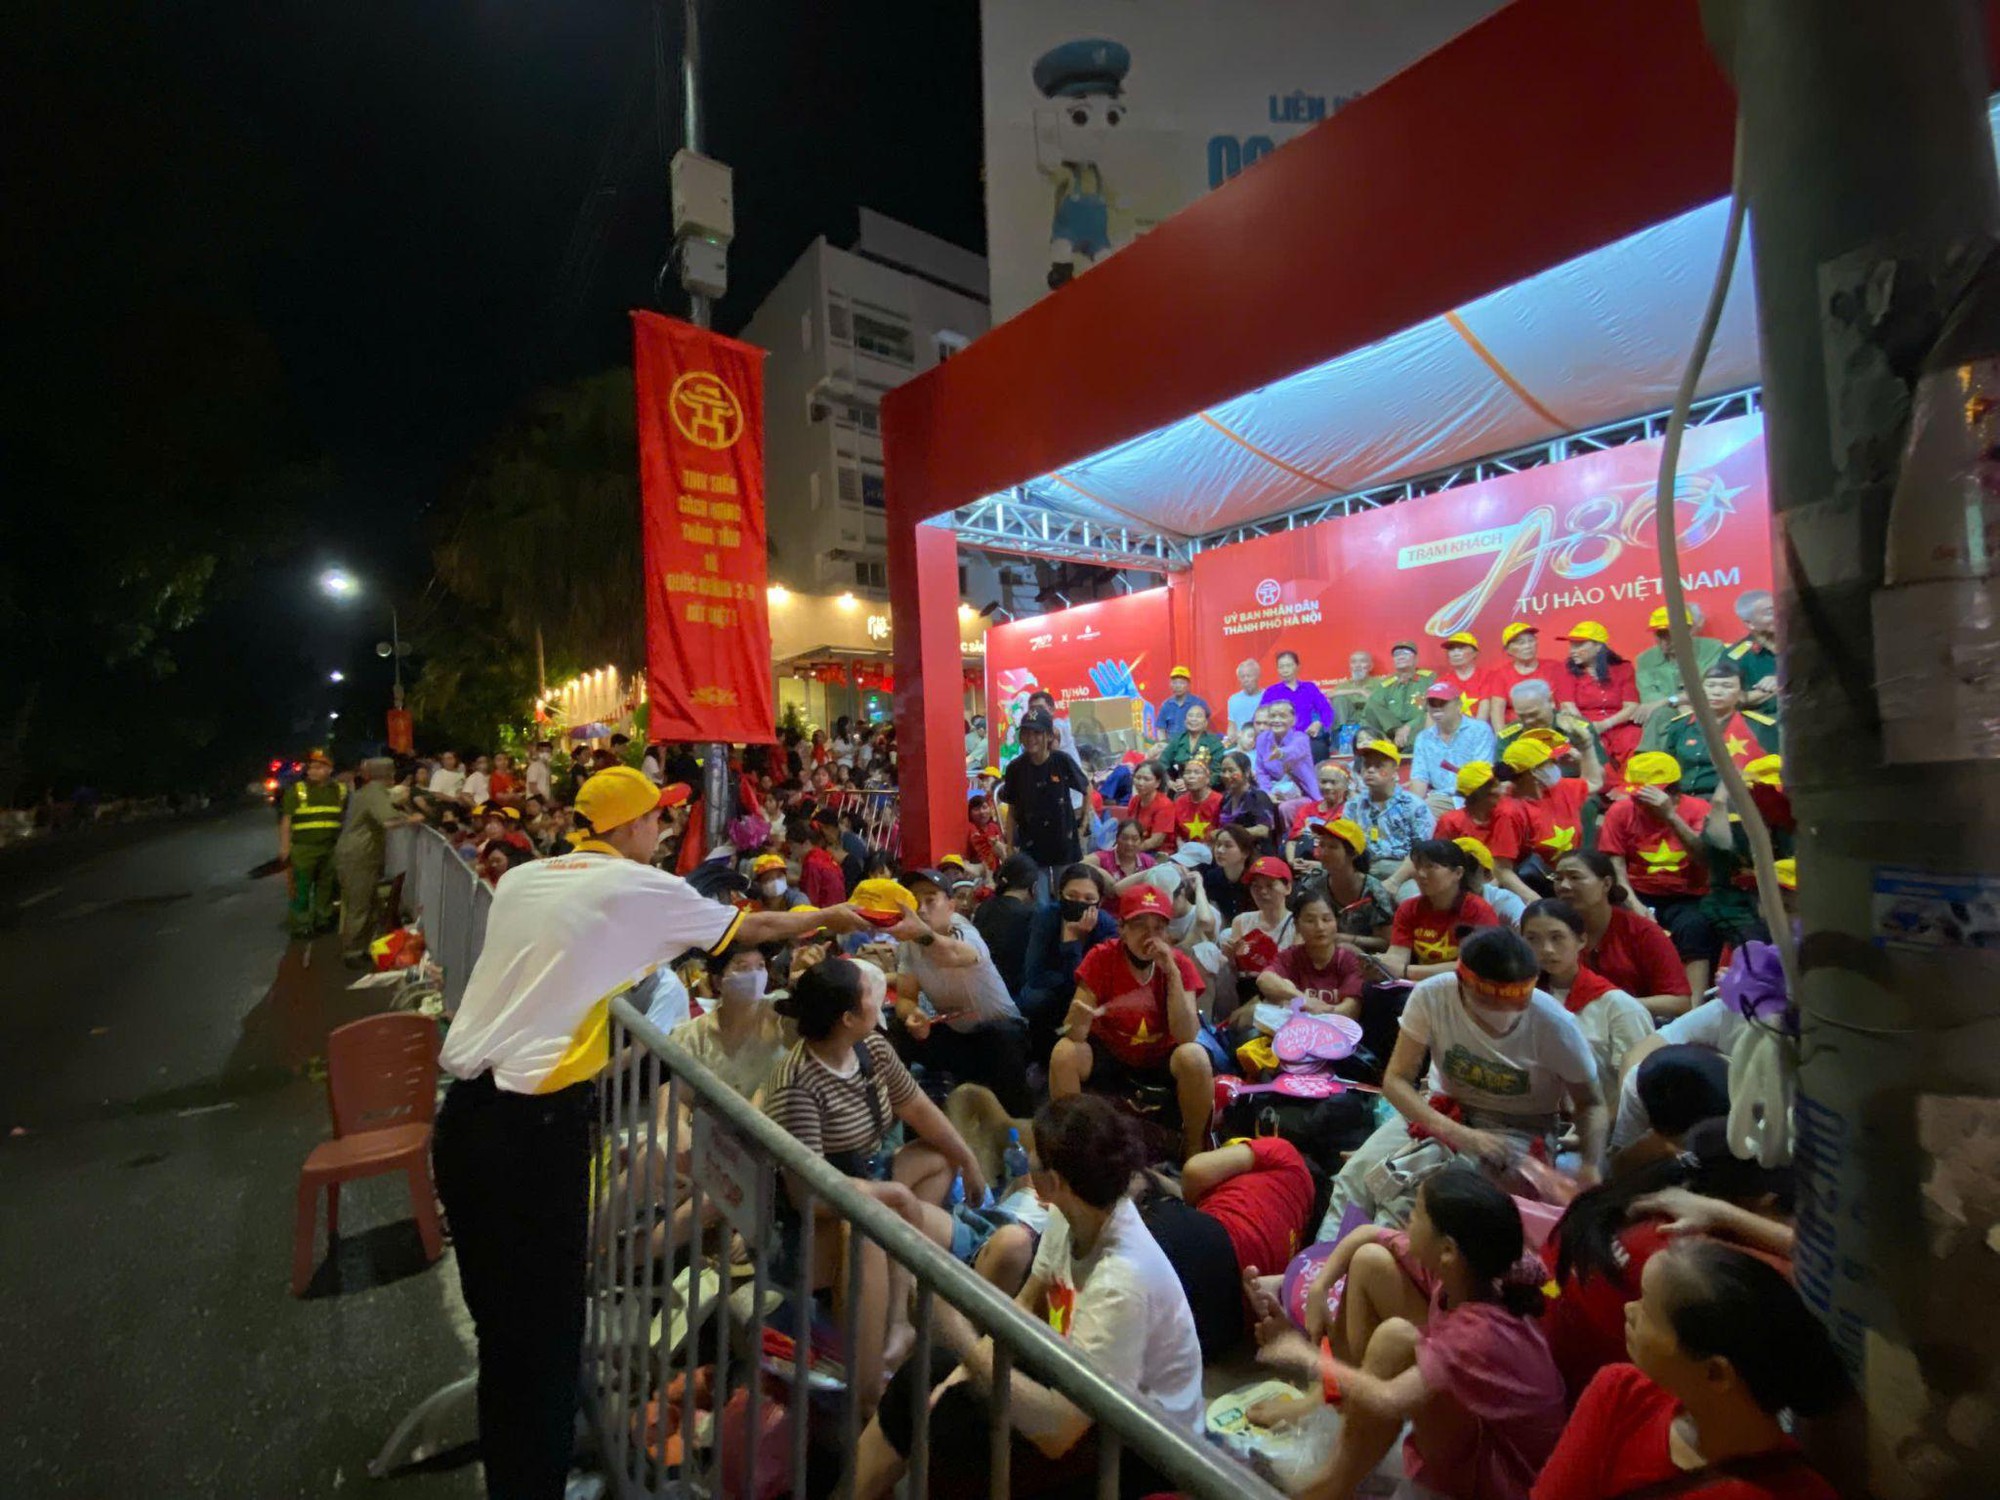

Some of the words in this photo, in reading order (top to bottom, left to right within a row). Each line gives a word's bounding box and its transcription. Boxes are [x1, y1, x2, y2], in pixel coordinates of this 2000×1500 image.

[1408, 543, 1446, 564] TRẠM
[1450, 531, 1503, 554] KHÁCH
[1239, 609, 1261, 622] BAN
[1262, 603, 1294, 619] NHÂN
[1294, 598, 1320, 614] DÂN
[1517, 593, 1549, 615] TỰ
[1553, 586, 1605, 609] HÀO
[1222, 622, 1258, 636] THÀNH
[1259, 616, 1282, 631] PHỐ
[1283, 614, 1301, 627] HÀ
[1301, 610, 1322, 625] NỘI
